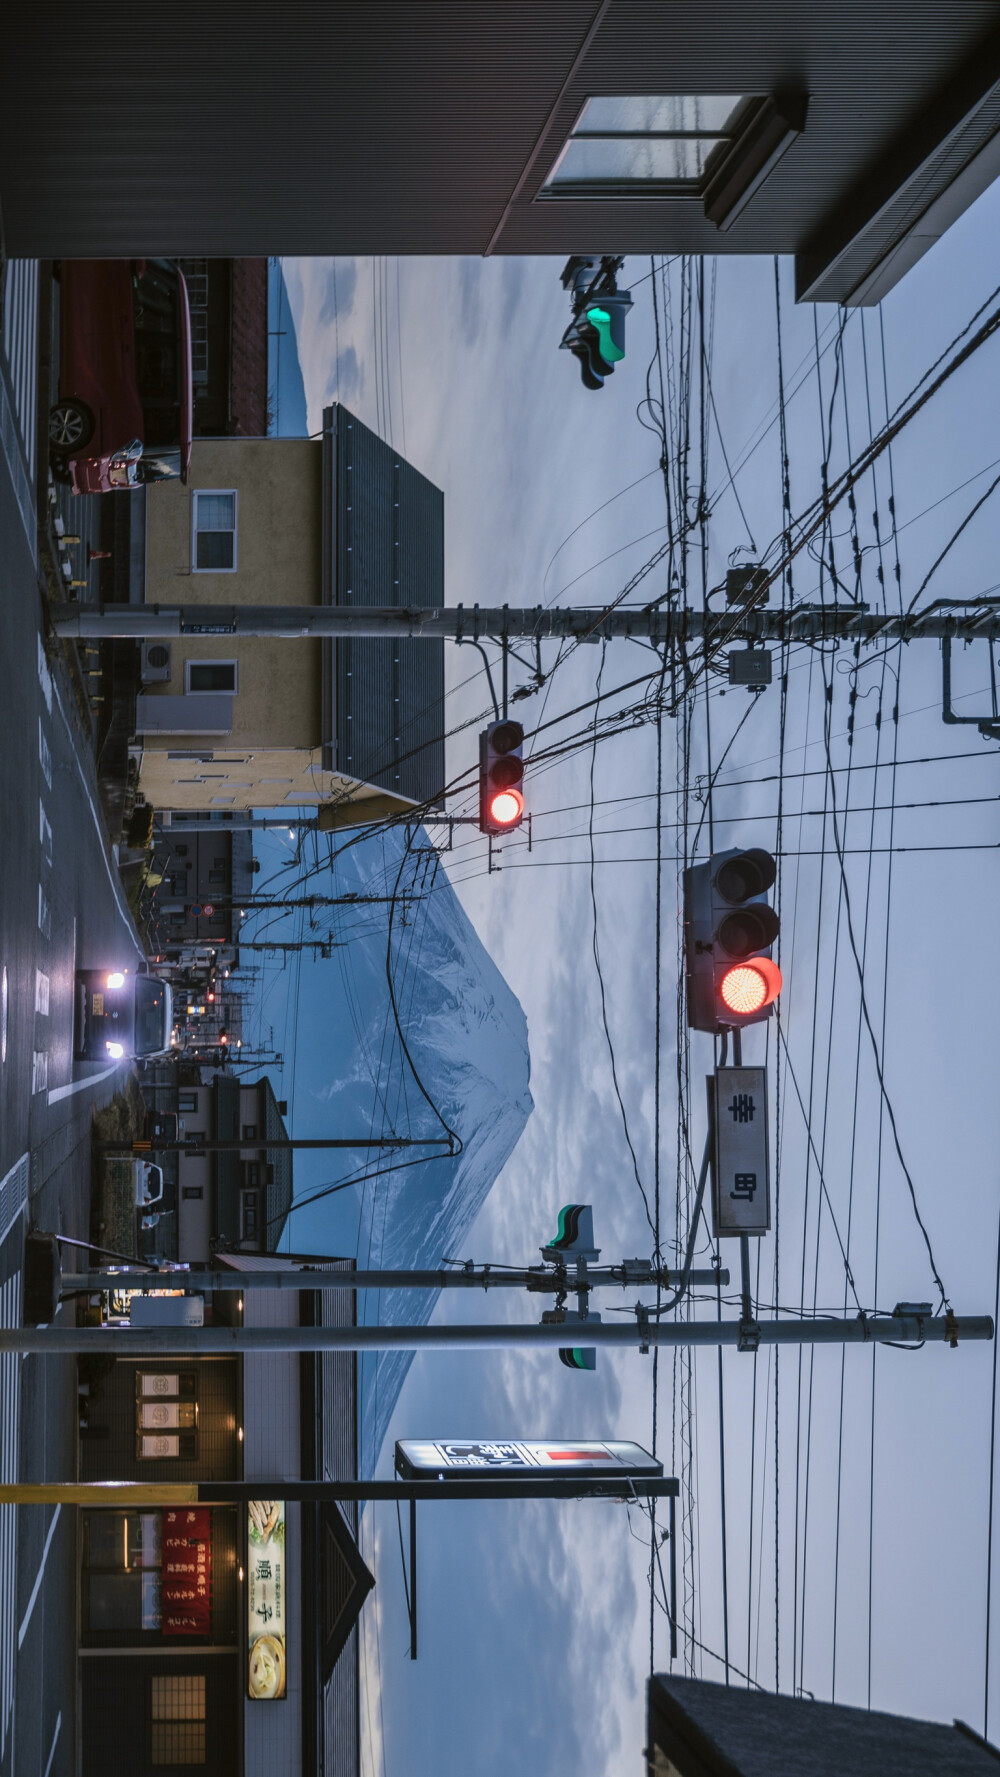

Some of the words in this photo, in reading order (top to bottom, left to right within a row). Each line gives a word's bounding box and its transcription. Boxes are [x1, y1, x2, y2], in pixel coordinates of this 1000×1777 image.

[728, 1094, 756, 1202] 幸町
[166, 1564, 196, 1573] 家庭料理
[196, 1544, 206, 1596] 居酒屋順子
[256, 1560, 272, 1624] 順子
[166, 1590, 196, 1600] ホルモン
